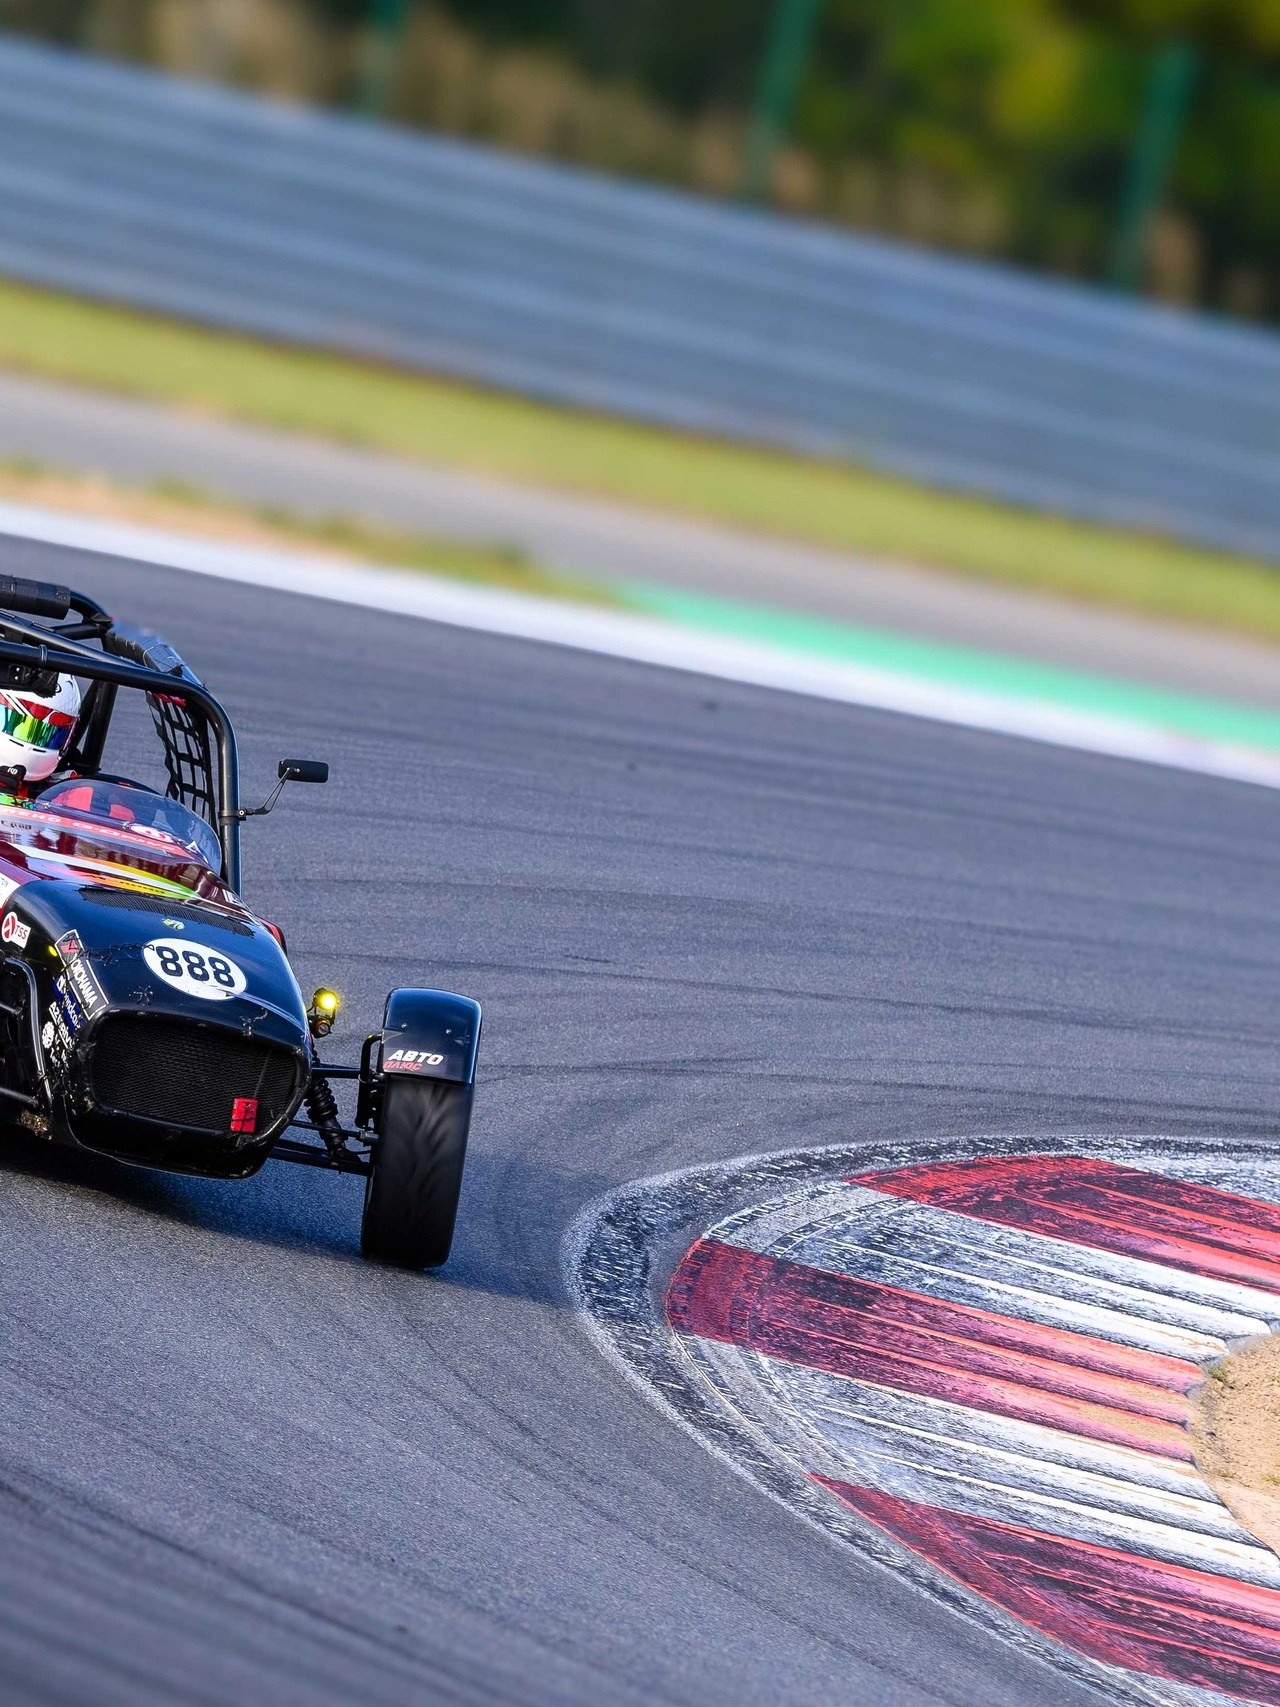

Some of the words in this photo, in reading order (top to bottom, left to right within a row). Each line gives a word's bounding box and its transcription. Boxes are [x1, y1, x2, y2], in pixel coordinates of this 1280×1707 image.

[70, 952, 99, 1009] YOKOHAMA
[154, 946, 236, 988] 888
[382, 1060, 423, 1071] ПЛЮС
[387, 1049, 444, 1066] АВТО
